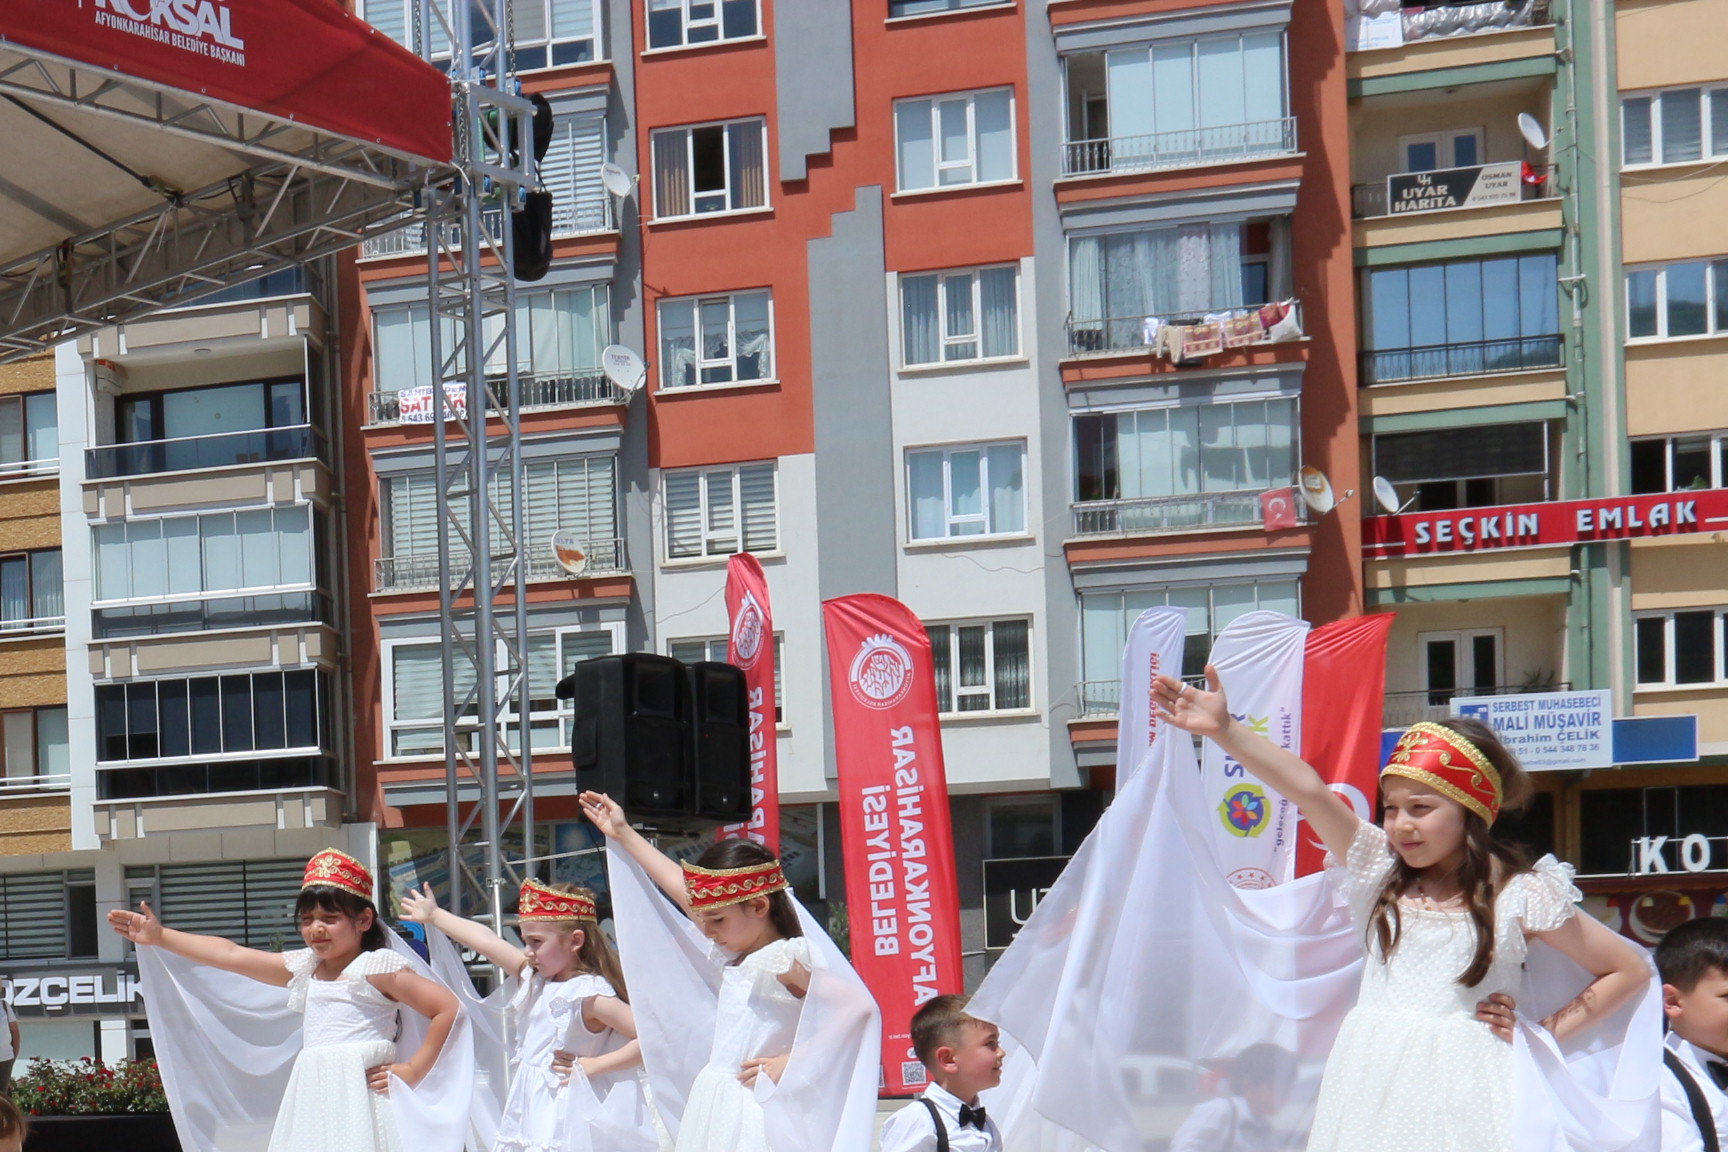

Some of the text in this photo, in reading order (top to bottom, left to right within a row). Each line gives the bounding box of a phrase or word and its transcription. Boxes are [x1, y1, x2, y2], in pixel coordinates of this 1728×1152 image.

[94, 10, 247, 68] AFYONKARAHİSAR BELEDİYE BAŞKANI
[1402, 184, 1449, 200] UYAR
[1485, 180, 1509, 189] UYAR
[1394, 195, 1457, 212] HARİTA
[1414, 500, 1697, 545] SEÇKİN EMLAK
[1492, 694, 1602, 714] SERBEST MUHASEBECİ
[1493, 708, 1603, 732] MALİ MÜŞAVİR
[1556, 729, 1601, 745] ÇELİK
